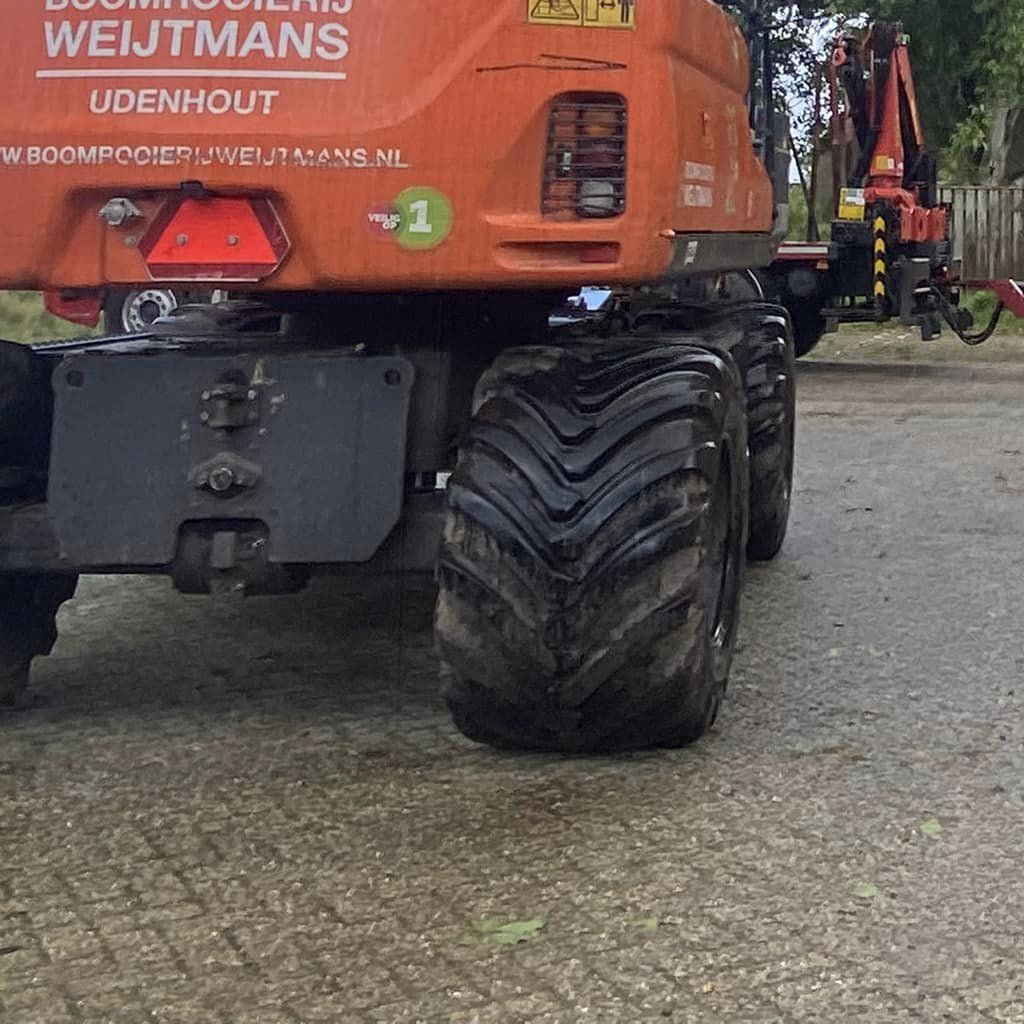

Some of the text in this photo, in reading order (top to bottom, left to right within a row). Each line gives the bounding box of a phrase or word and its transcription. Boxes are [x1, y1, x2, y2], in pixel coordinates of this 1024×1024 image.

[43, 19, 350, 61] WEIJTMANS
[88, 88, 280, 115] UDENHOUT
[0, 145, 409, 169] W.BOOMROOIERIJWEIJTMANS.NL
[382, 221, 397, 230] OP
[408, 199, 432, 232] 1
